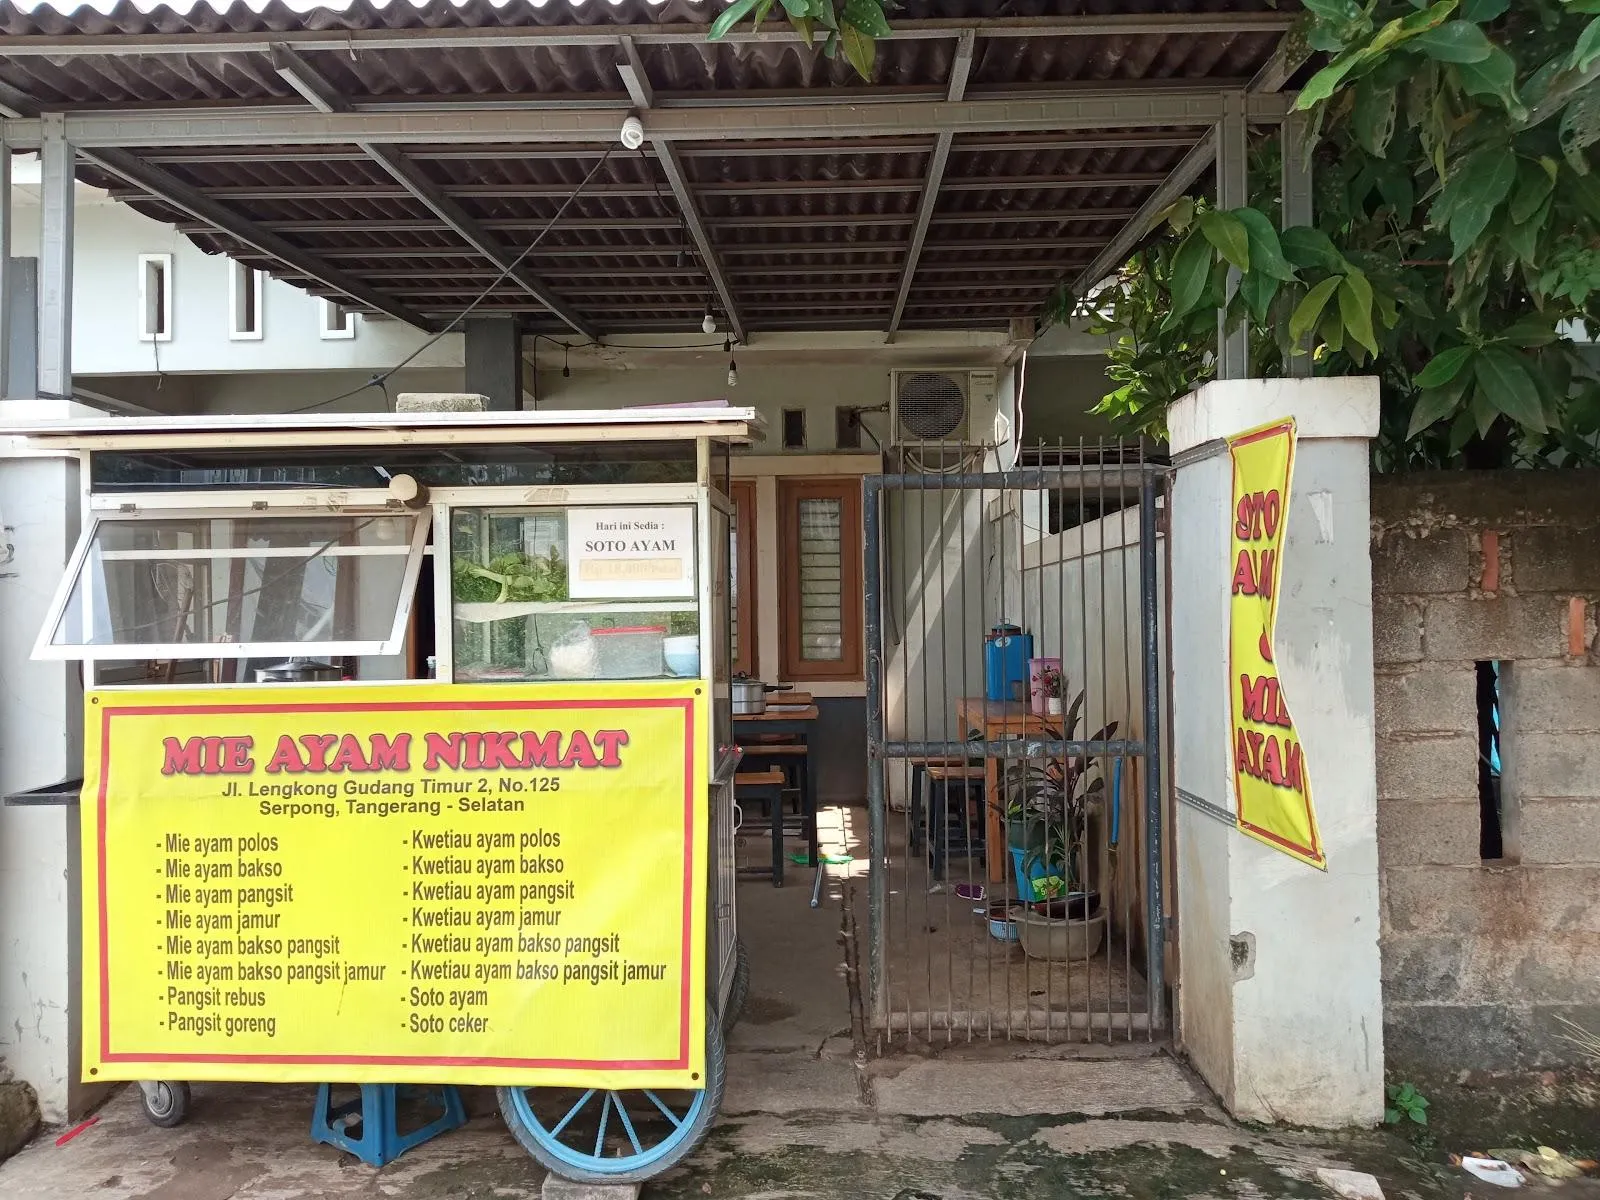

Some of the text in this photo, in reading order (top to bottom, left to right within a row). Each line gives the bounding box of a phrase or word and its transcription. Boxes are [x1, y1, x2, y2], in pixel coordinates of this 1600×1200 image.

[596, 522, 617, 530] Hari
[620, 522, 631, 530] ini
[585, 540, 675, 552] SOTO AYAM
[1232, 549, 1274, 600] AM
[161, 729, 630, 775] MIE AYAM NIKMAT
[1238, 727, 1302, 792] AYAM
[222, 777, 560, 799] Jl. Lengkong Gudang Timur 2, No.125
[260, 801, 339, 818] Serpong,
[346, 799, 440, 816] Tangerang
[459, 797, 524, 812] Selatan
[166, 833, 190, 852] Mie
[195, 838, 232, 857] ayam
[238, 832, 278, 856] polos
[413, 829, 471, 849] Kwetiau
[477, 833, 514, 853] ayam
[520, 828, 560, 852] polos
[166, 859, 190, 878] Mie
[195, 864, 232, 882] ayam
[238, 858, 282, 877] bakso
[413, 855, 471, 874] Kwetiau
[477, 859, 515, 879] ayam
[520, 854, 563, 873] bakso
[166, 884, 190, 903] Mie
[196, 889, 232, 908] ayam
[238, 883, 293, 908] pangsit
[413, 880, 471, 900] Kwetiau
[477, 885, 514, 904] ayam
[520, 880, 574, 904] pangsit
[166, 910, 191, 929] Mie
[196, 915, 232, 934] ayam
[237, 910, 280, 934] jamur
[413, 907, 471, 926] Kwetiau
[476, 911, 514, 930] ayam
[518, 906, 561, 931] jamur
[167, 935, 192, 954] Mie
[197, 940, 232, 959] ayam
[238, 935, 282, 955] bakso
[288, 935, 340, 959] pangsit
[412, 933, 471, 953] Kwetiau
[476, 937, 513, 957] ayam
[518, 932, 561, 952] bakso
[565, 932, 619, 957] pangsit
[167, 961, 192, 980] Mie
[197, 965, 233, 985] ayam
[238, 961, 282, 980] bakso
[288, 961, 340, 984] pangsit
[344, 961, 386, 985] jamur
[411, 960, 470, 980] Kwetiau
[475, 964, 511, 984] ayam
[516, 959, 558, 980] bakso
[564, 960, 619, 985] pangsit
[622, 960, 666, 985] jamur
[168, 986, 221, 1010] Pangsit
[225, 987, 265, 1006] rebus
[410, 987, 444, 1006] Soto
[449, 990, 487, 1008] ayam
[169, 1011, 221, 1036] Pangsit
[225, 1018, 275, 1037] goreng
[410, 1013, 444, 1033] Soto
[449, 1012, 488, 1032] ceker
